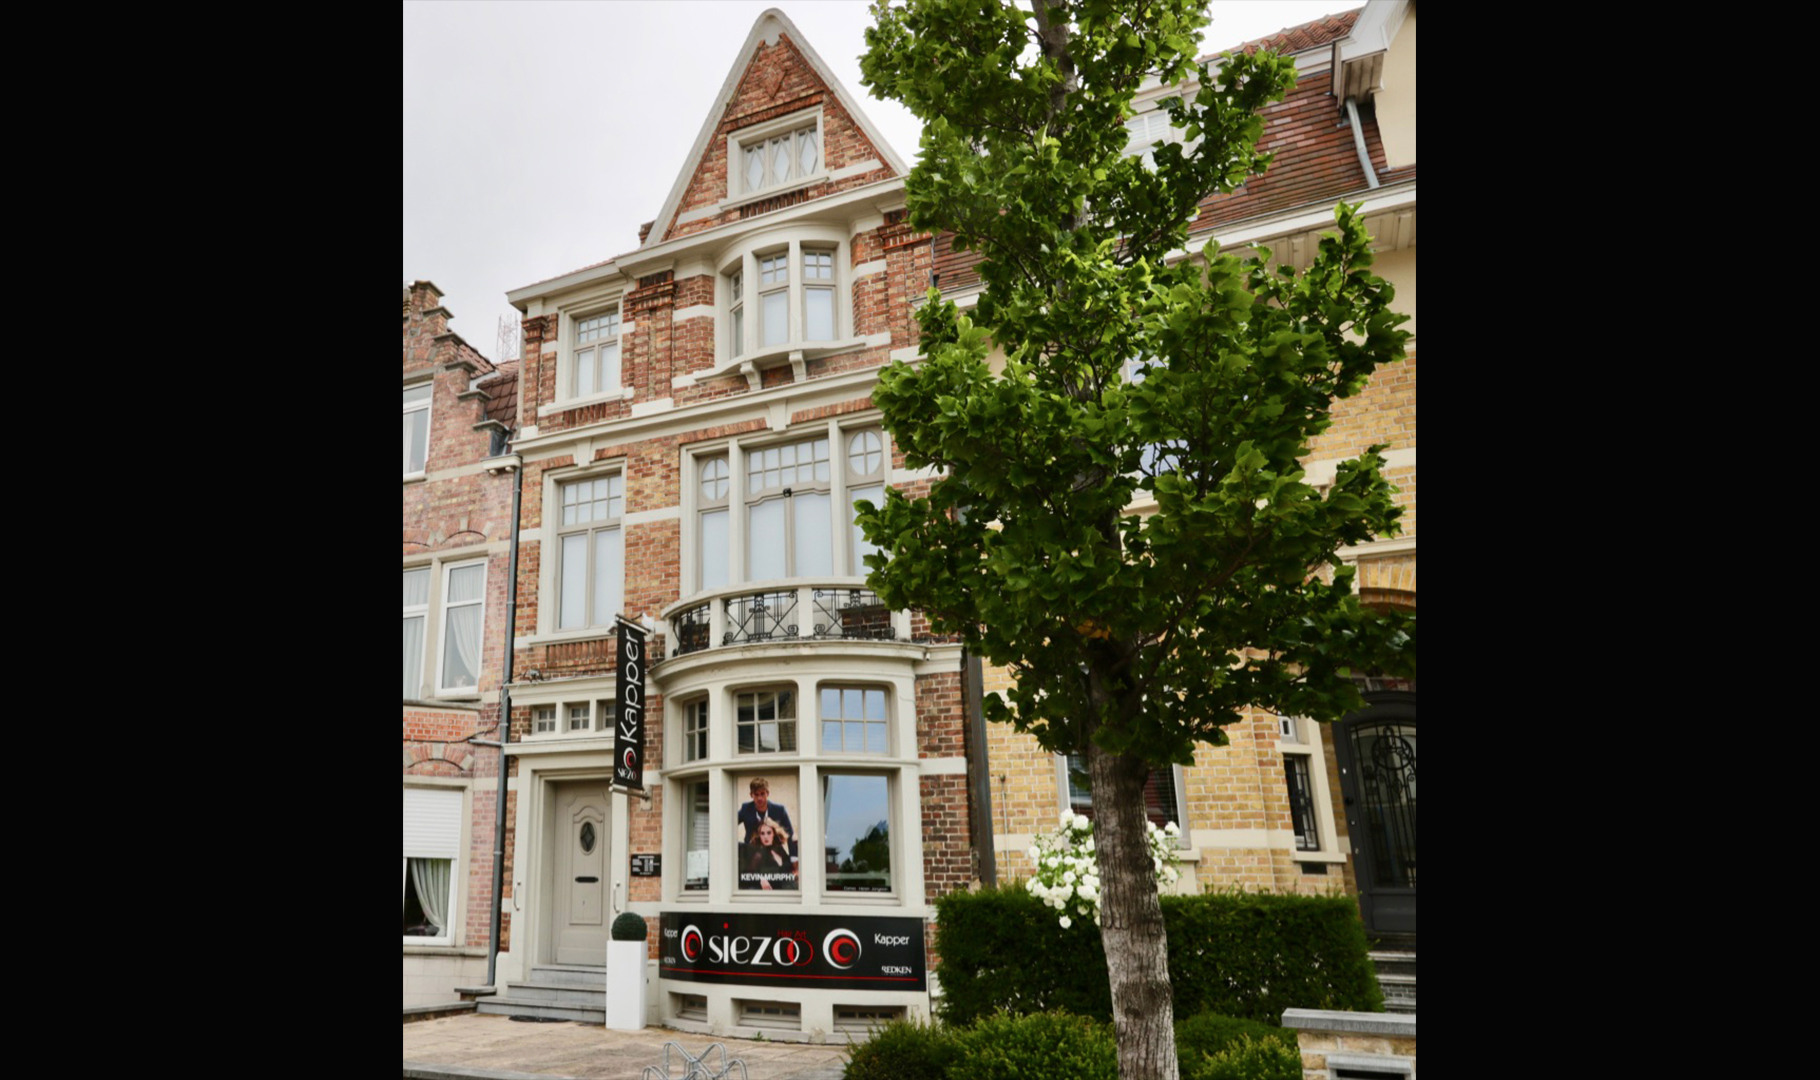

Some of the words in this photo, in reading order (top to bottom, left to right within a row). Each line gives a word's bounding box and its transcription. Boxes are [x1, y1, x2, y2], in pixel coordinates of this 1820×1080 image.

[620, 629, 642, 743] Kapper
[874, 933, 910, 947] Kapper
[881, 965, 912, 974] REDKEN
